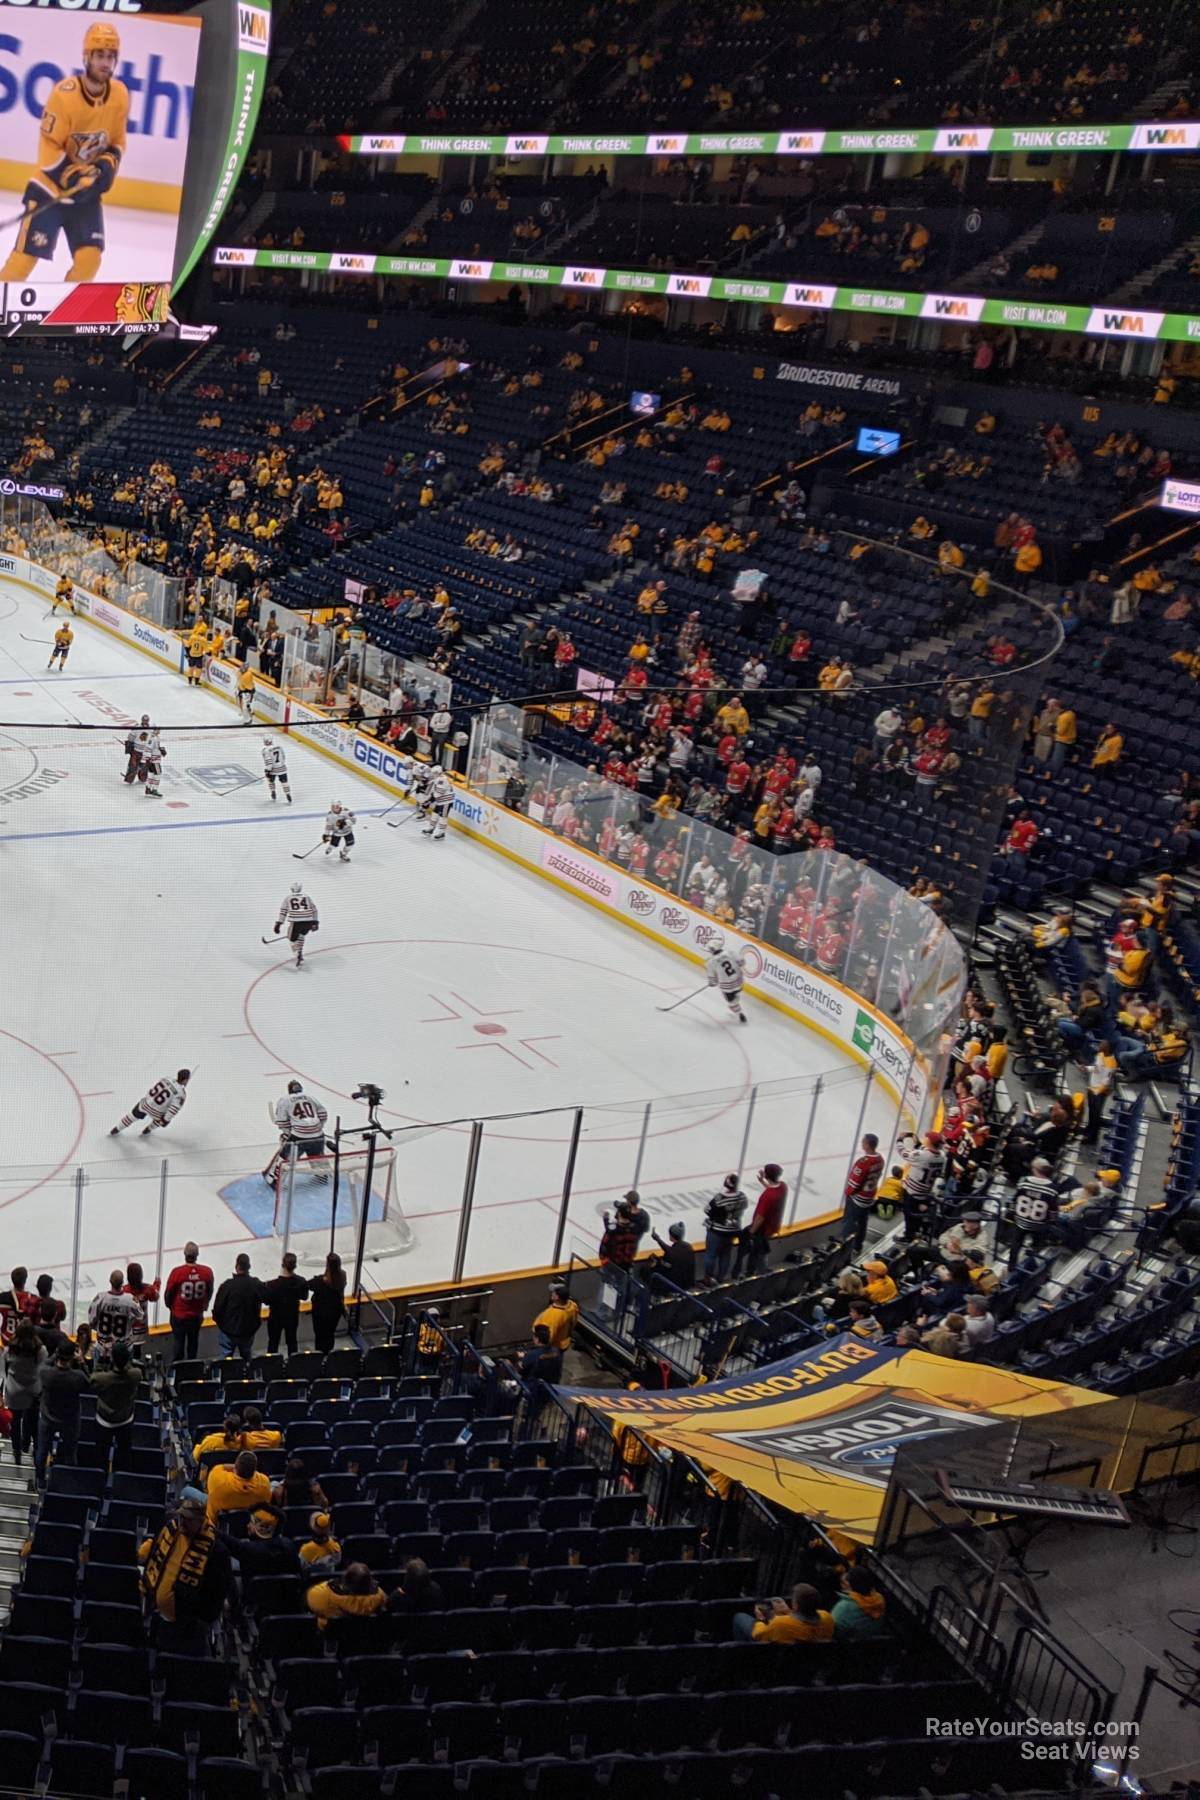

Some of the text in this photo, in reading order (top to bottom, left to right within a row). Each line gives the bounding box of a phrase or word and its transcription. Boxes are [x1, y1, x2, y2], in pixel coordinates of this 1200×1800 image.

[238, 9, 267, 41] WM
[232, 70, 255, 145] THINK
[369, 138, 396, 150] WM
[420, 138, 451, 151] THINK
[563, 138, 593, 151] THINK
[655, 138, 680, 150] WM
[701, 136, 728, 150] THINK
[787, 136, 814, 149] WM
[840, 135, 874, 149] THINK
[947, 133, 979, 148] WM
[1012, 131, 1054, 147] THINK
[1146, 129, 1187, 145] WM
[514, 140, 539, 151] WM
[218, 250, 245, 262] WM
[339, 256, 365, 269] WM
[458, 263, 483, 275] WM
[572, 270, 597, 284] WM
[676, 279, 702, 292] WM
[20, 288, 37, 306] 0
[794, 288, 824, 303] WM
[934, 300, 969, 316] WM
[1003, 306, 1067, 324] VISIT WM.COM
[1103, 314, 1144, 332] WM
[777, 362, 864, 389] BRIDGESTONE
[861, 376, 900, 395] ARENA
[15, 482, 64, 499] LEXUS
[133, 622, 166, 652] Southwest
[548, 855, 612, 897] PREDATORS
[290, 896, 309, 911] 64
[720, 960, 736, 977] 2
[764, 957, 844, 1015] IntelliCentrics
[292, 1101, 315, 1120] 40
[1015, 1195, 1048, 1221] 88
[98, 1312, 128, 1337] 88
[577, 1341, 880, 1411] BUYFORDNOW.COM
[770, 1410, 935, 1453] TOUGH
